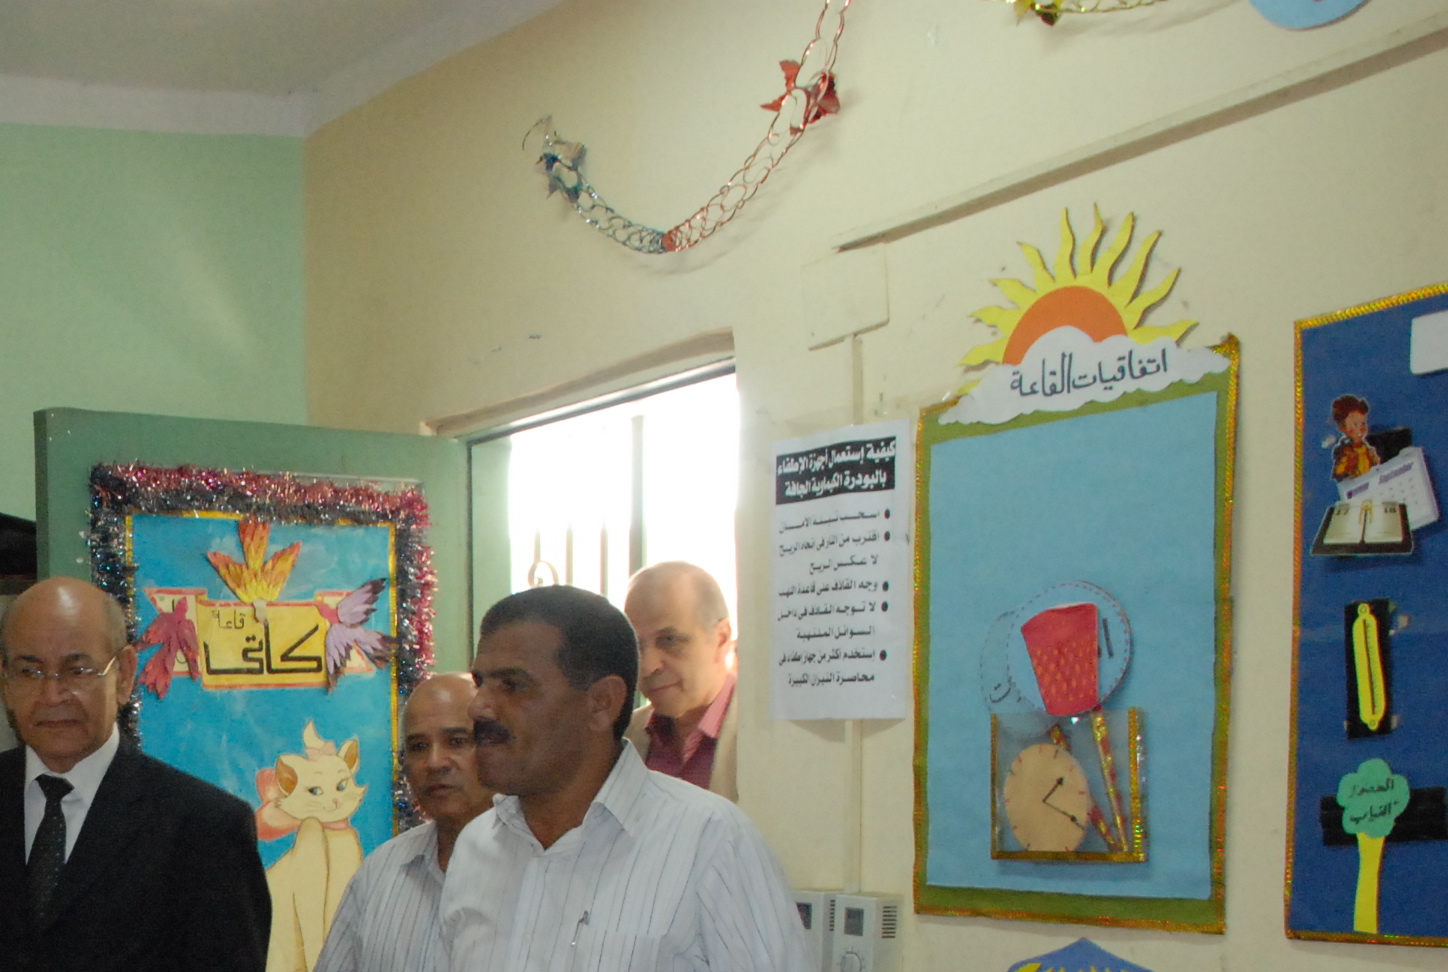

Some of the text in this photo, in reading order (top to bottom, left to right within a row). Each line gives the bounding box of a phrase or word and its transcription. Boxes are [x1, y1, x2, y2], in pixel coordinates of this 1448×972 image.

[1010, 348, 1168, 397] اتفاقيات القاعة
[777, 440, 896, 476] كيفية إستعمال أجهزة الإطفاء
[784, 470, 887, 499] بالبودرة الكيماوية الجافة
